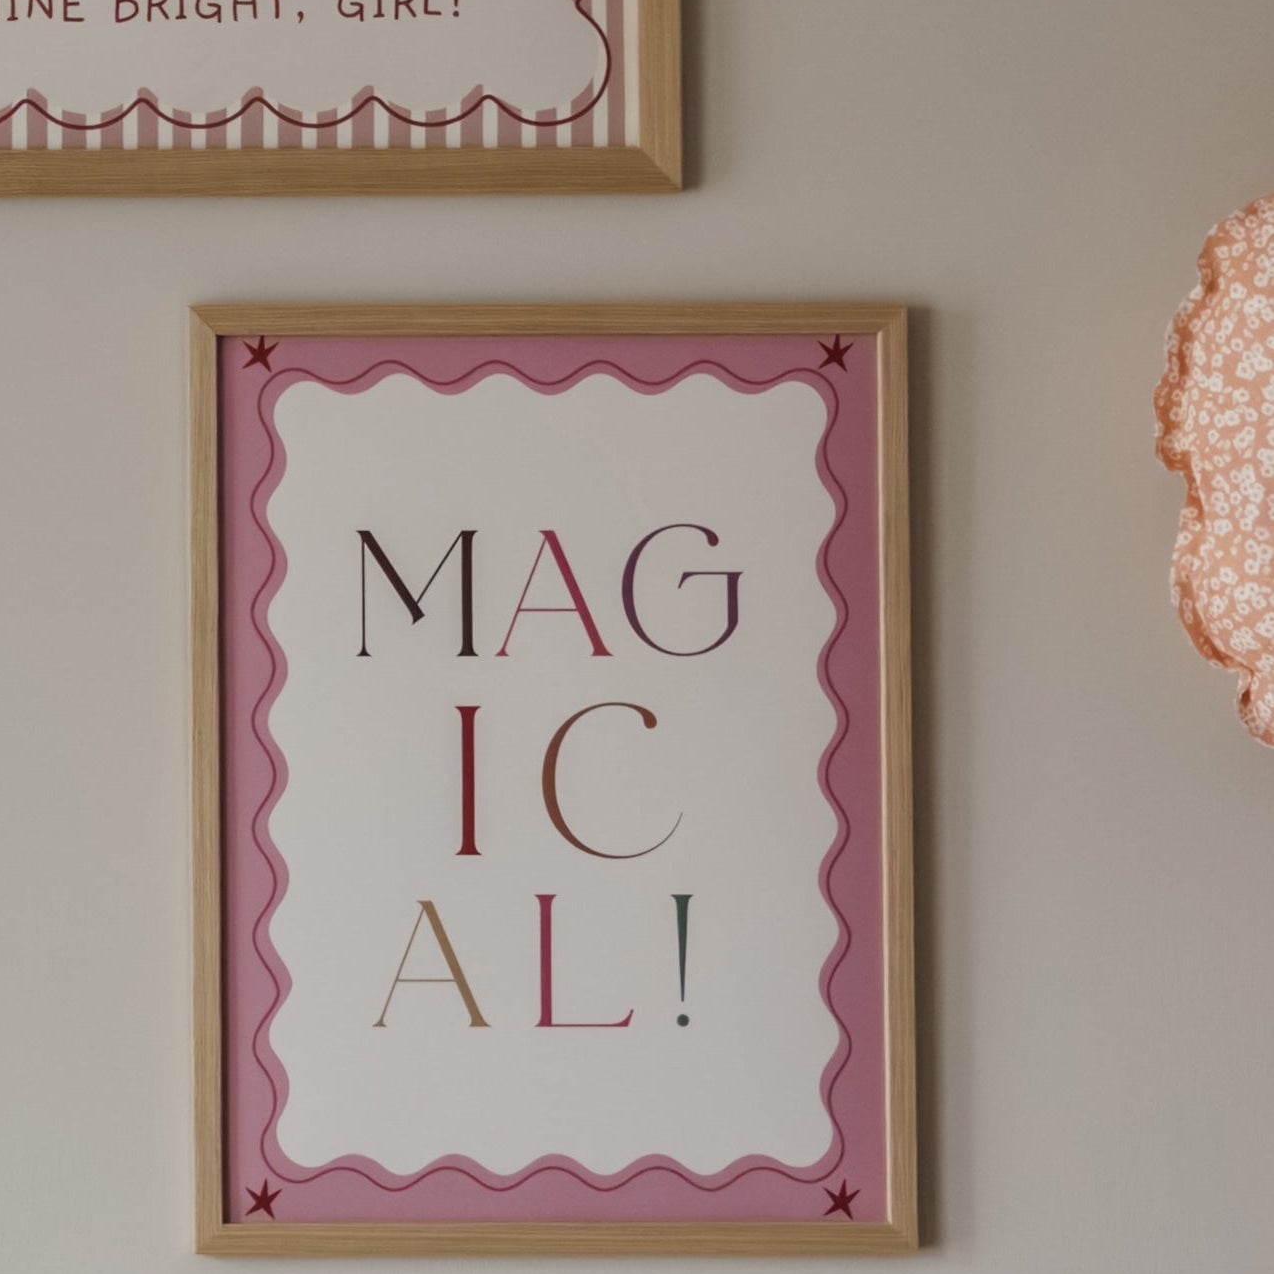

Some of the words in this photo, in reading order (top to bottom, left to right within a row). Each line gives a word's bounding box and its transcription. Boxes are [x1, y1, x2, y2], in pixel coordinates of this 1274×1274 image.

[355, 523, 744, 658] MAG
[455, 701, 684, 860] IC
[371, 893, 694, 1029] AL!
